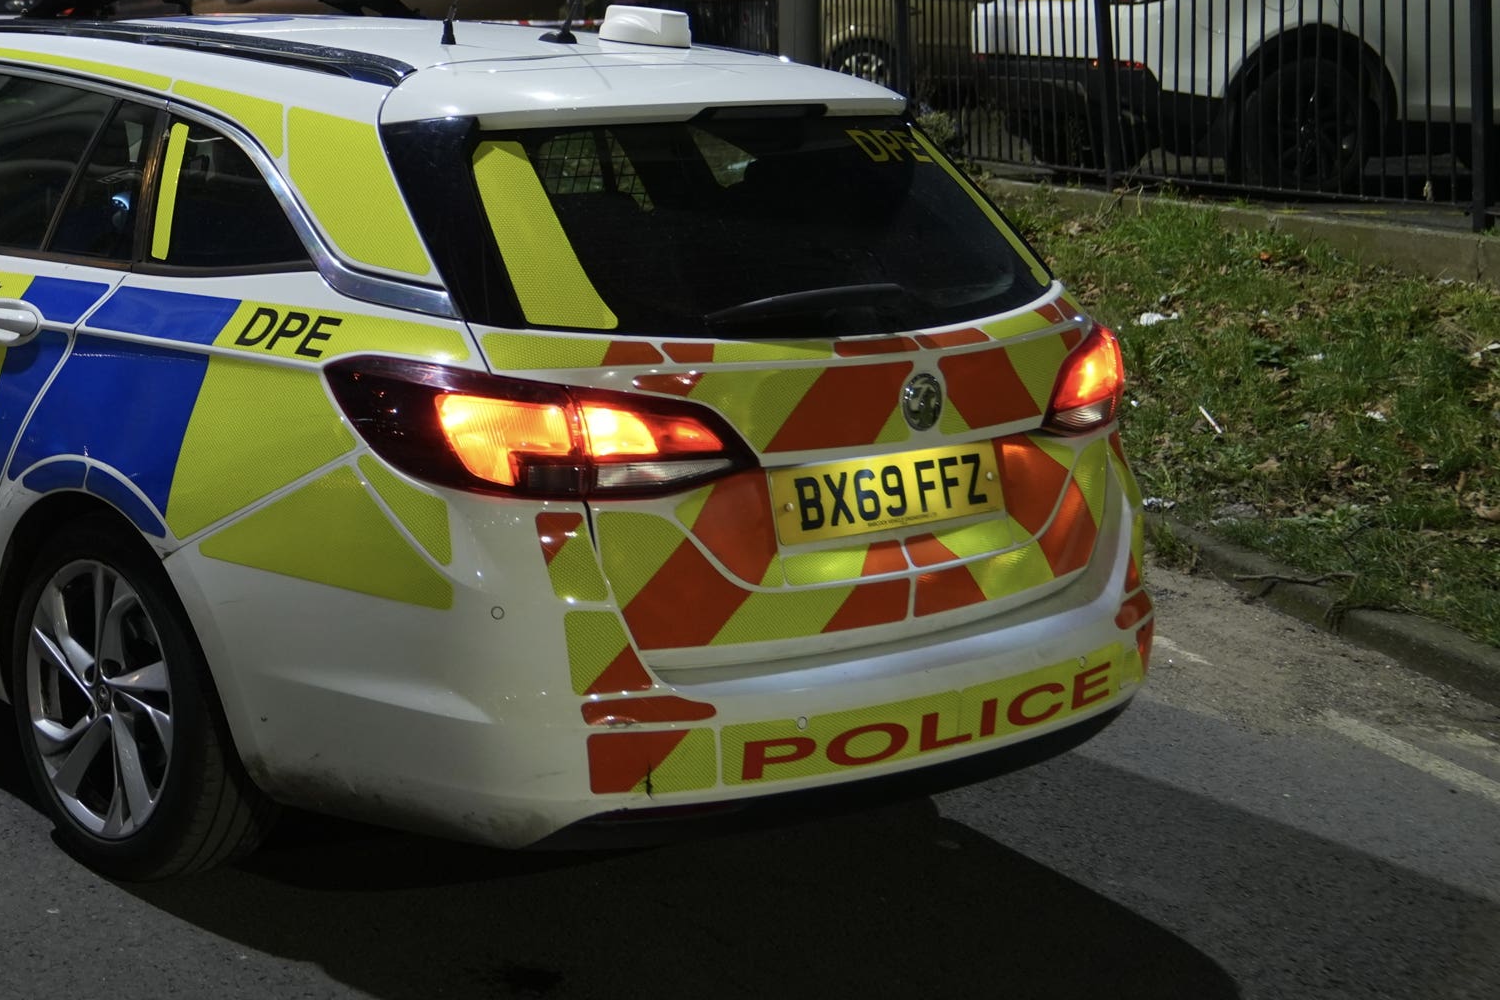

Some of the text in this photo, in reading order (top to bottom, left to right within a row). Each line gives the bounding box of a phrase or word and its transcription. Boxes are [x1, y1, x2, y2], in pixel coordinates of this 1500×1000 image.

[846, 128, 934, 164] DPE
[234, 307, 343, 358] DPE
[794, 453, 988, 531] BX69 FFZ
[740, 661, 1112, 781] POLICE
